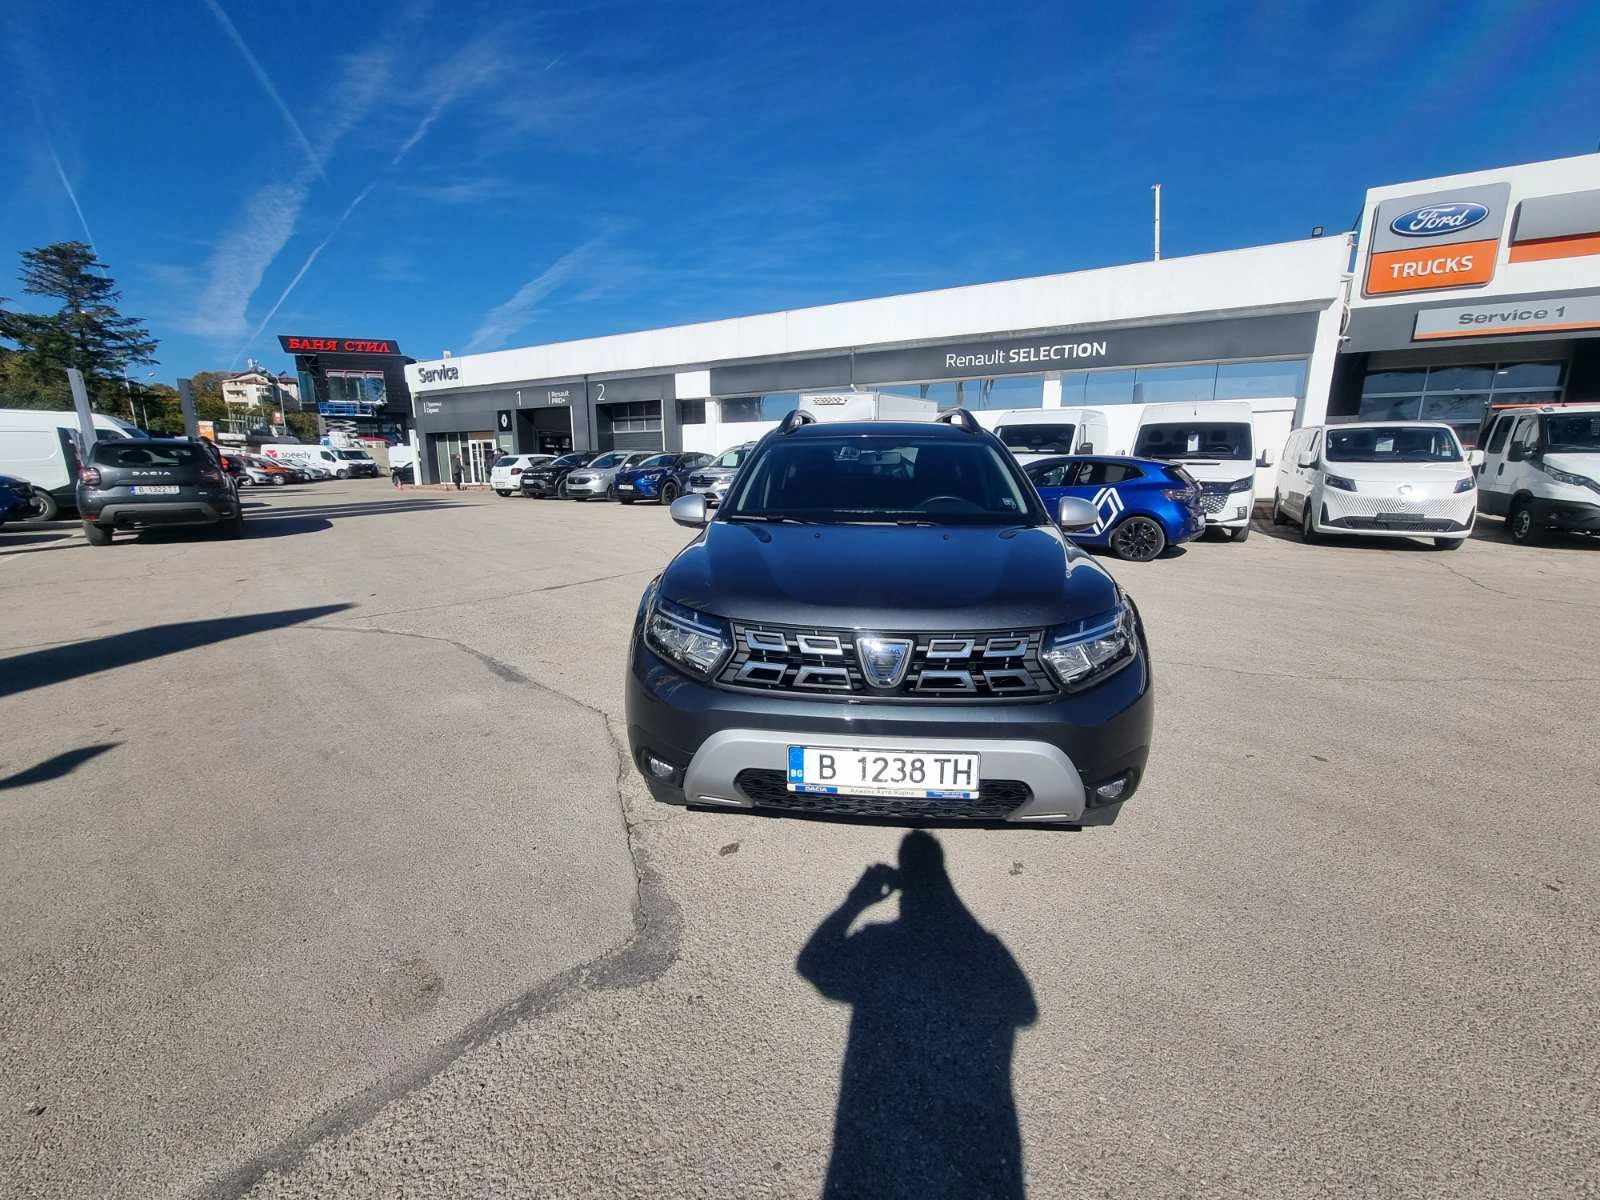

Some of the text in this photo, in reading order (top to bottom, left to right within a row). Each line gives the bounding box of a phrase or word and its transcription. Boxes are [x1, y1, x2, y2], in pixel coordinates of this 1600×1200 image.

[1409, 206, 1470, 231] Ford
[1390, 255, 1474, 279] TRUCKS
[1458, 306, 1566, 325] Service 1
[288, 338, 391, 353] БАНЯ СТИЛ
[945, 341, 1107, 368] Renault SELECTION
[418, 364, 459, 384] Service
[515, 390, 522, 407] 1
[596, 383, 606, 401] 2
[819, 754, 972, 785] B 1238 TH
